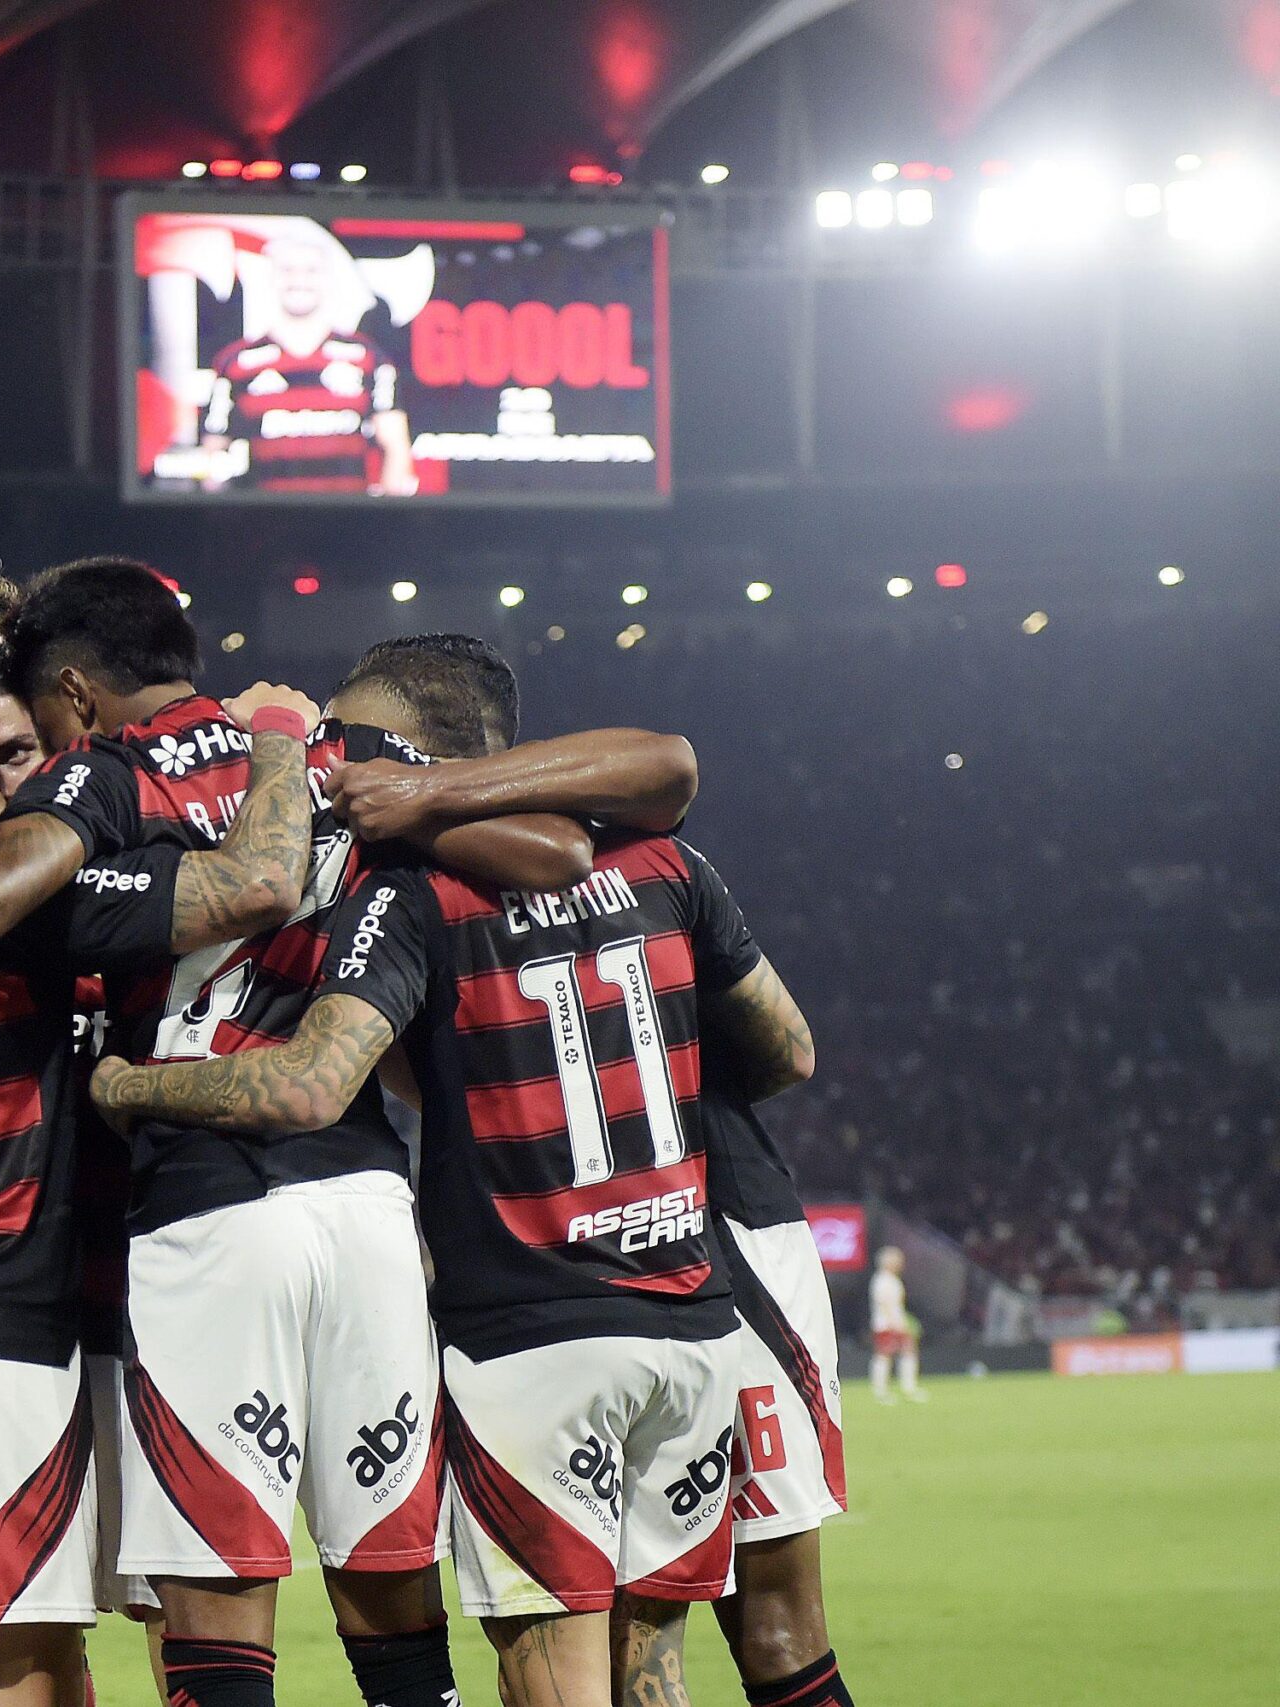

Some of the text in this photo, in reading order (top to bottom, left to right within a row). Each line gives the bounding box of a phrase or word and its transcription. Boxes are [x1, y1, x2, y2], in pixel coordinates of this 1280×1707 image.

[411, 299, 649, 388] GOOOL
[76, 868, 152, 894] opee
[337, 886, 397, 980] Shopee
[554, 980, 574, 1045] TEXACO
[626, 963, 646, 1027] TEXACO
[518, 935, 686, 1188] 11
[568, 1187, 698, 1244] ASSIST
[620, 1207, 705, 1254] CARD
[217, 1421, 284, 1498] da construção
[233, 1389, 302, 1484] abc
[345, 1391, 420, 1489] abc
[372, 1487, 390, 1504] da
[552, 1469, 617, 1538] da construção
[684, 1515, 702, 1532] da
